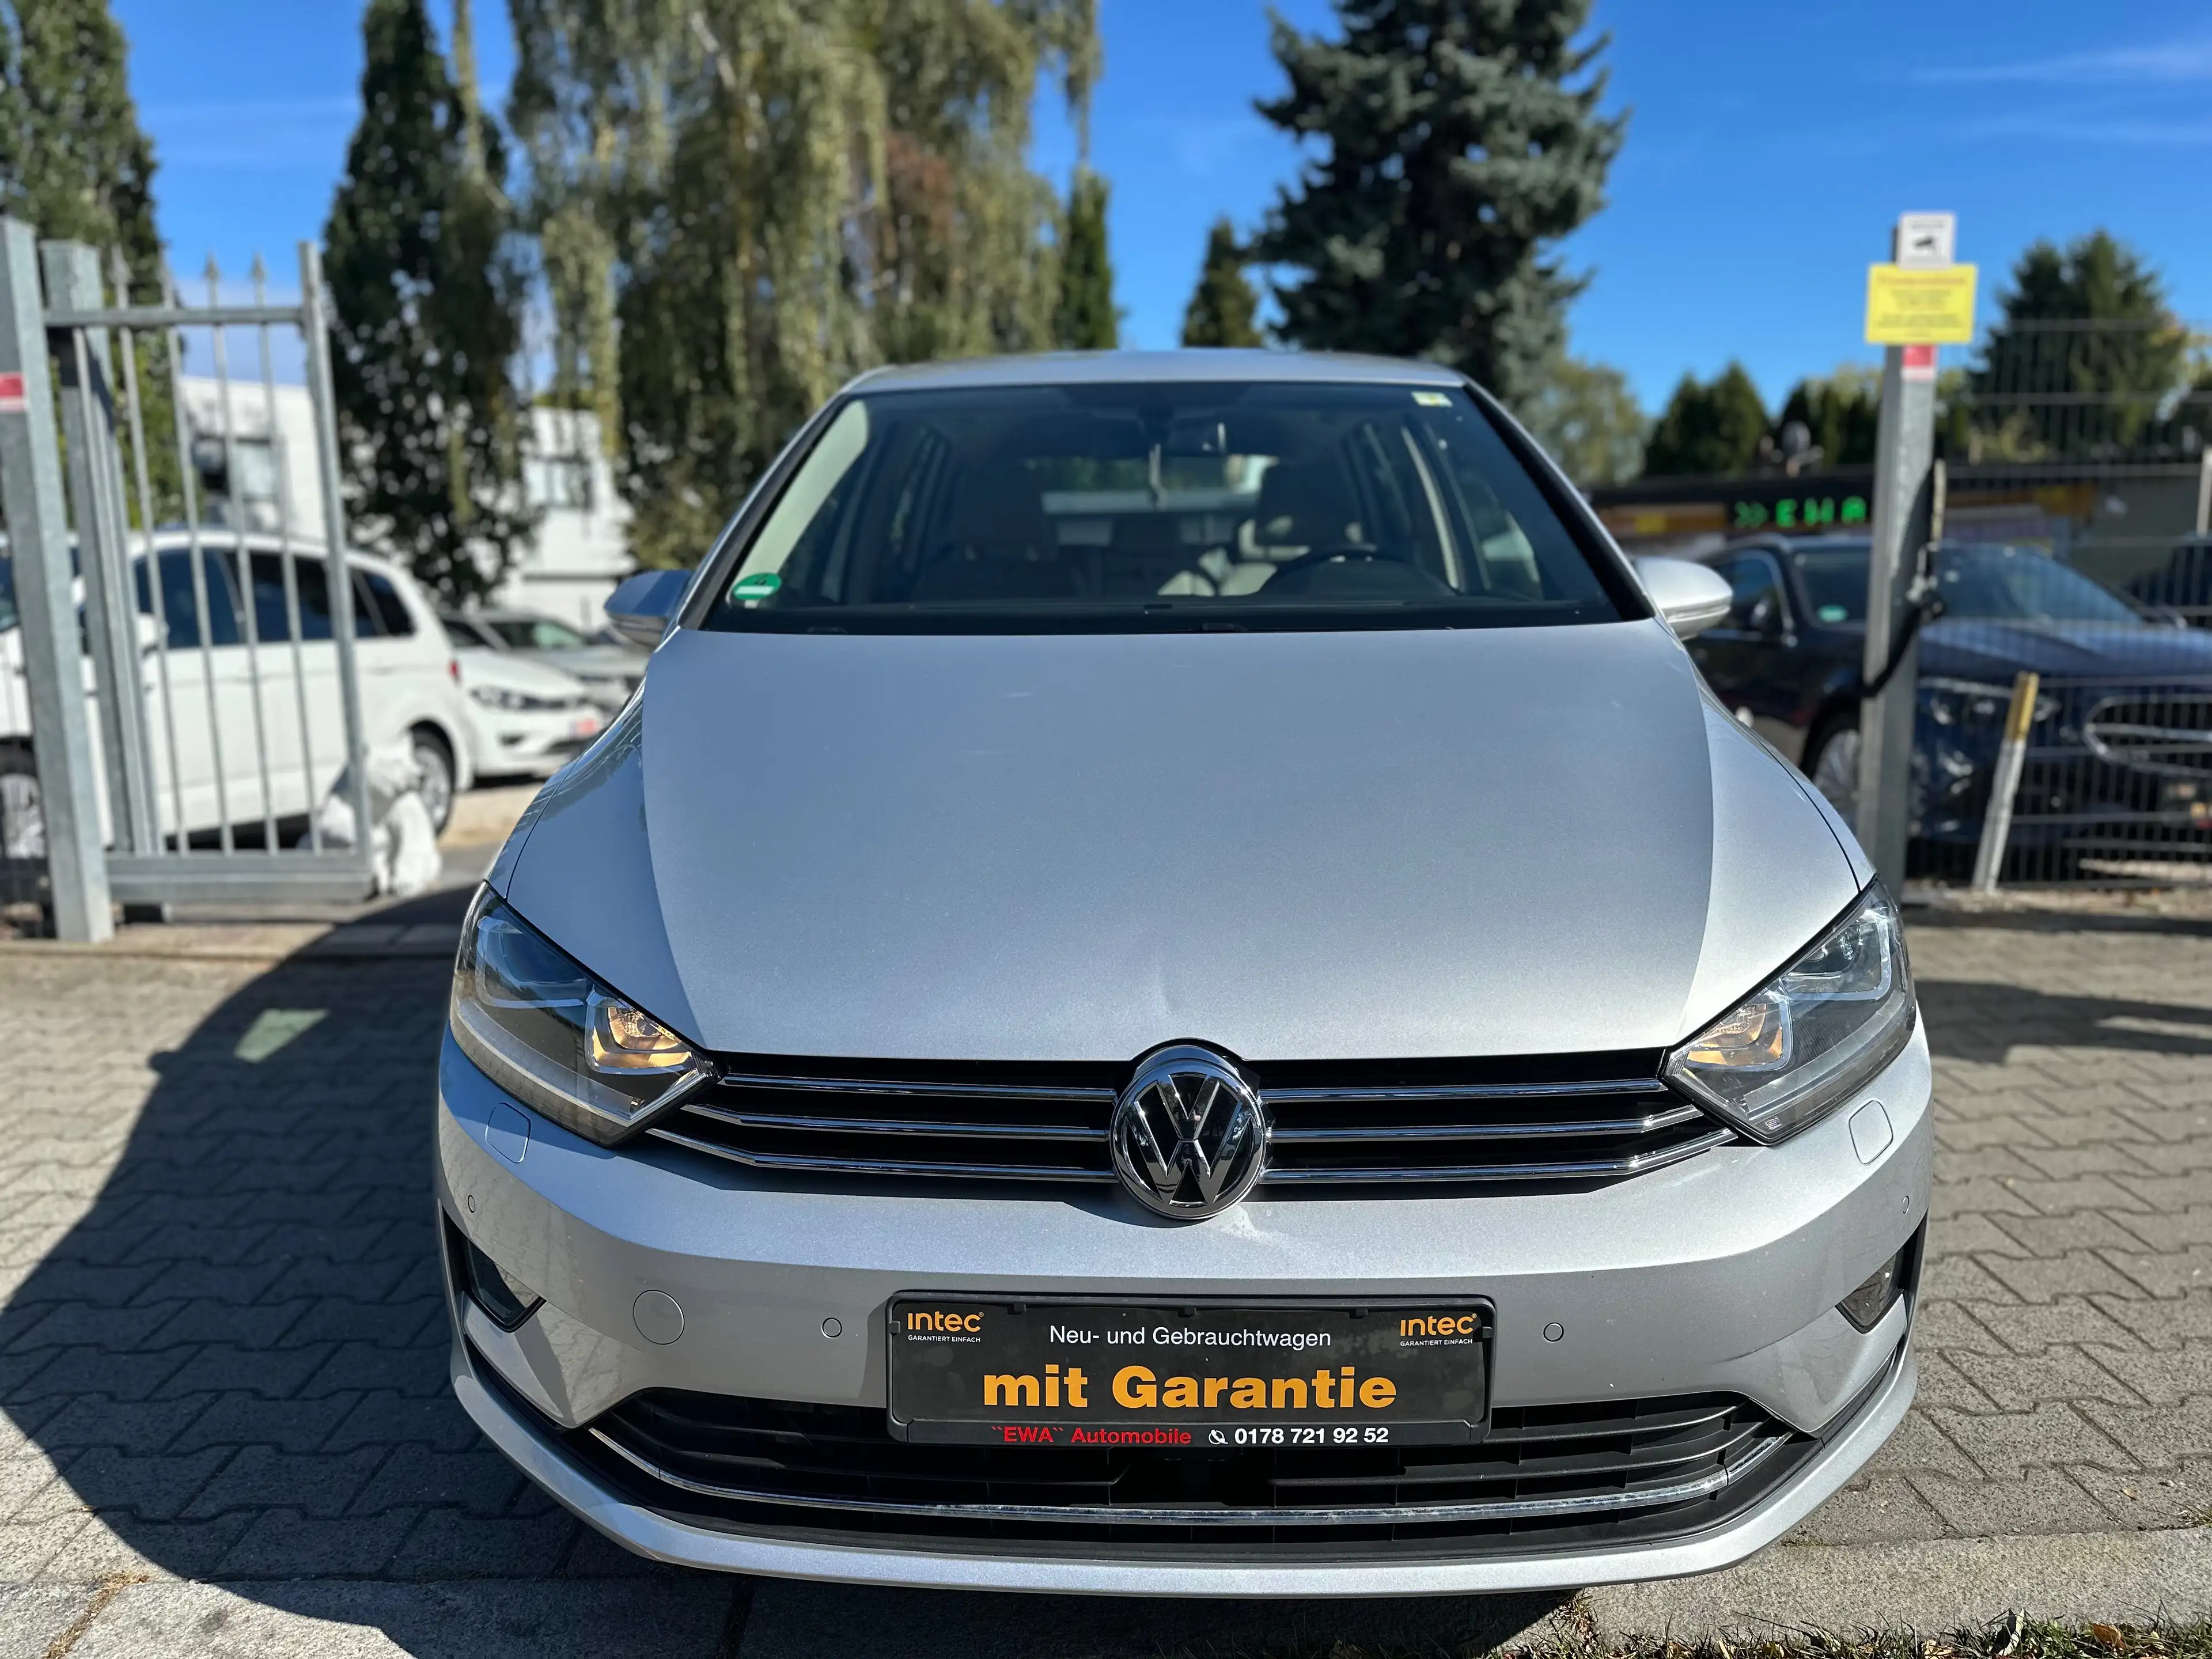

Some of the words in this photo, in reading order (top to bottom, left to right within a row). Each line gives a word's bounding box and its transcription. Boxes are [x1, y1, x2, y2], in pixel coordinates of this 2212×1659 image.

[1050, 1325, 1100, 1344] Neu-
[1107, 1327, 1145, 1344] und
[1152, 1327, 1331, 1351] Gebrauchtwagen
[984, 1364, 1088, 1407] mit
[1112, 1365, 1397, 1409] Garantie
[1070, 1427, 1192, 1444] Automobile
[1234, 1427, 1285, 1444] 0178
[1290, 1427, 1324, 1444] 721
[1332, 1427, 1358, 1444] 92
[1363, 1427, 1389, 1444] 52
